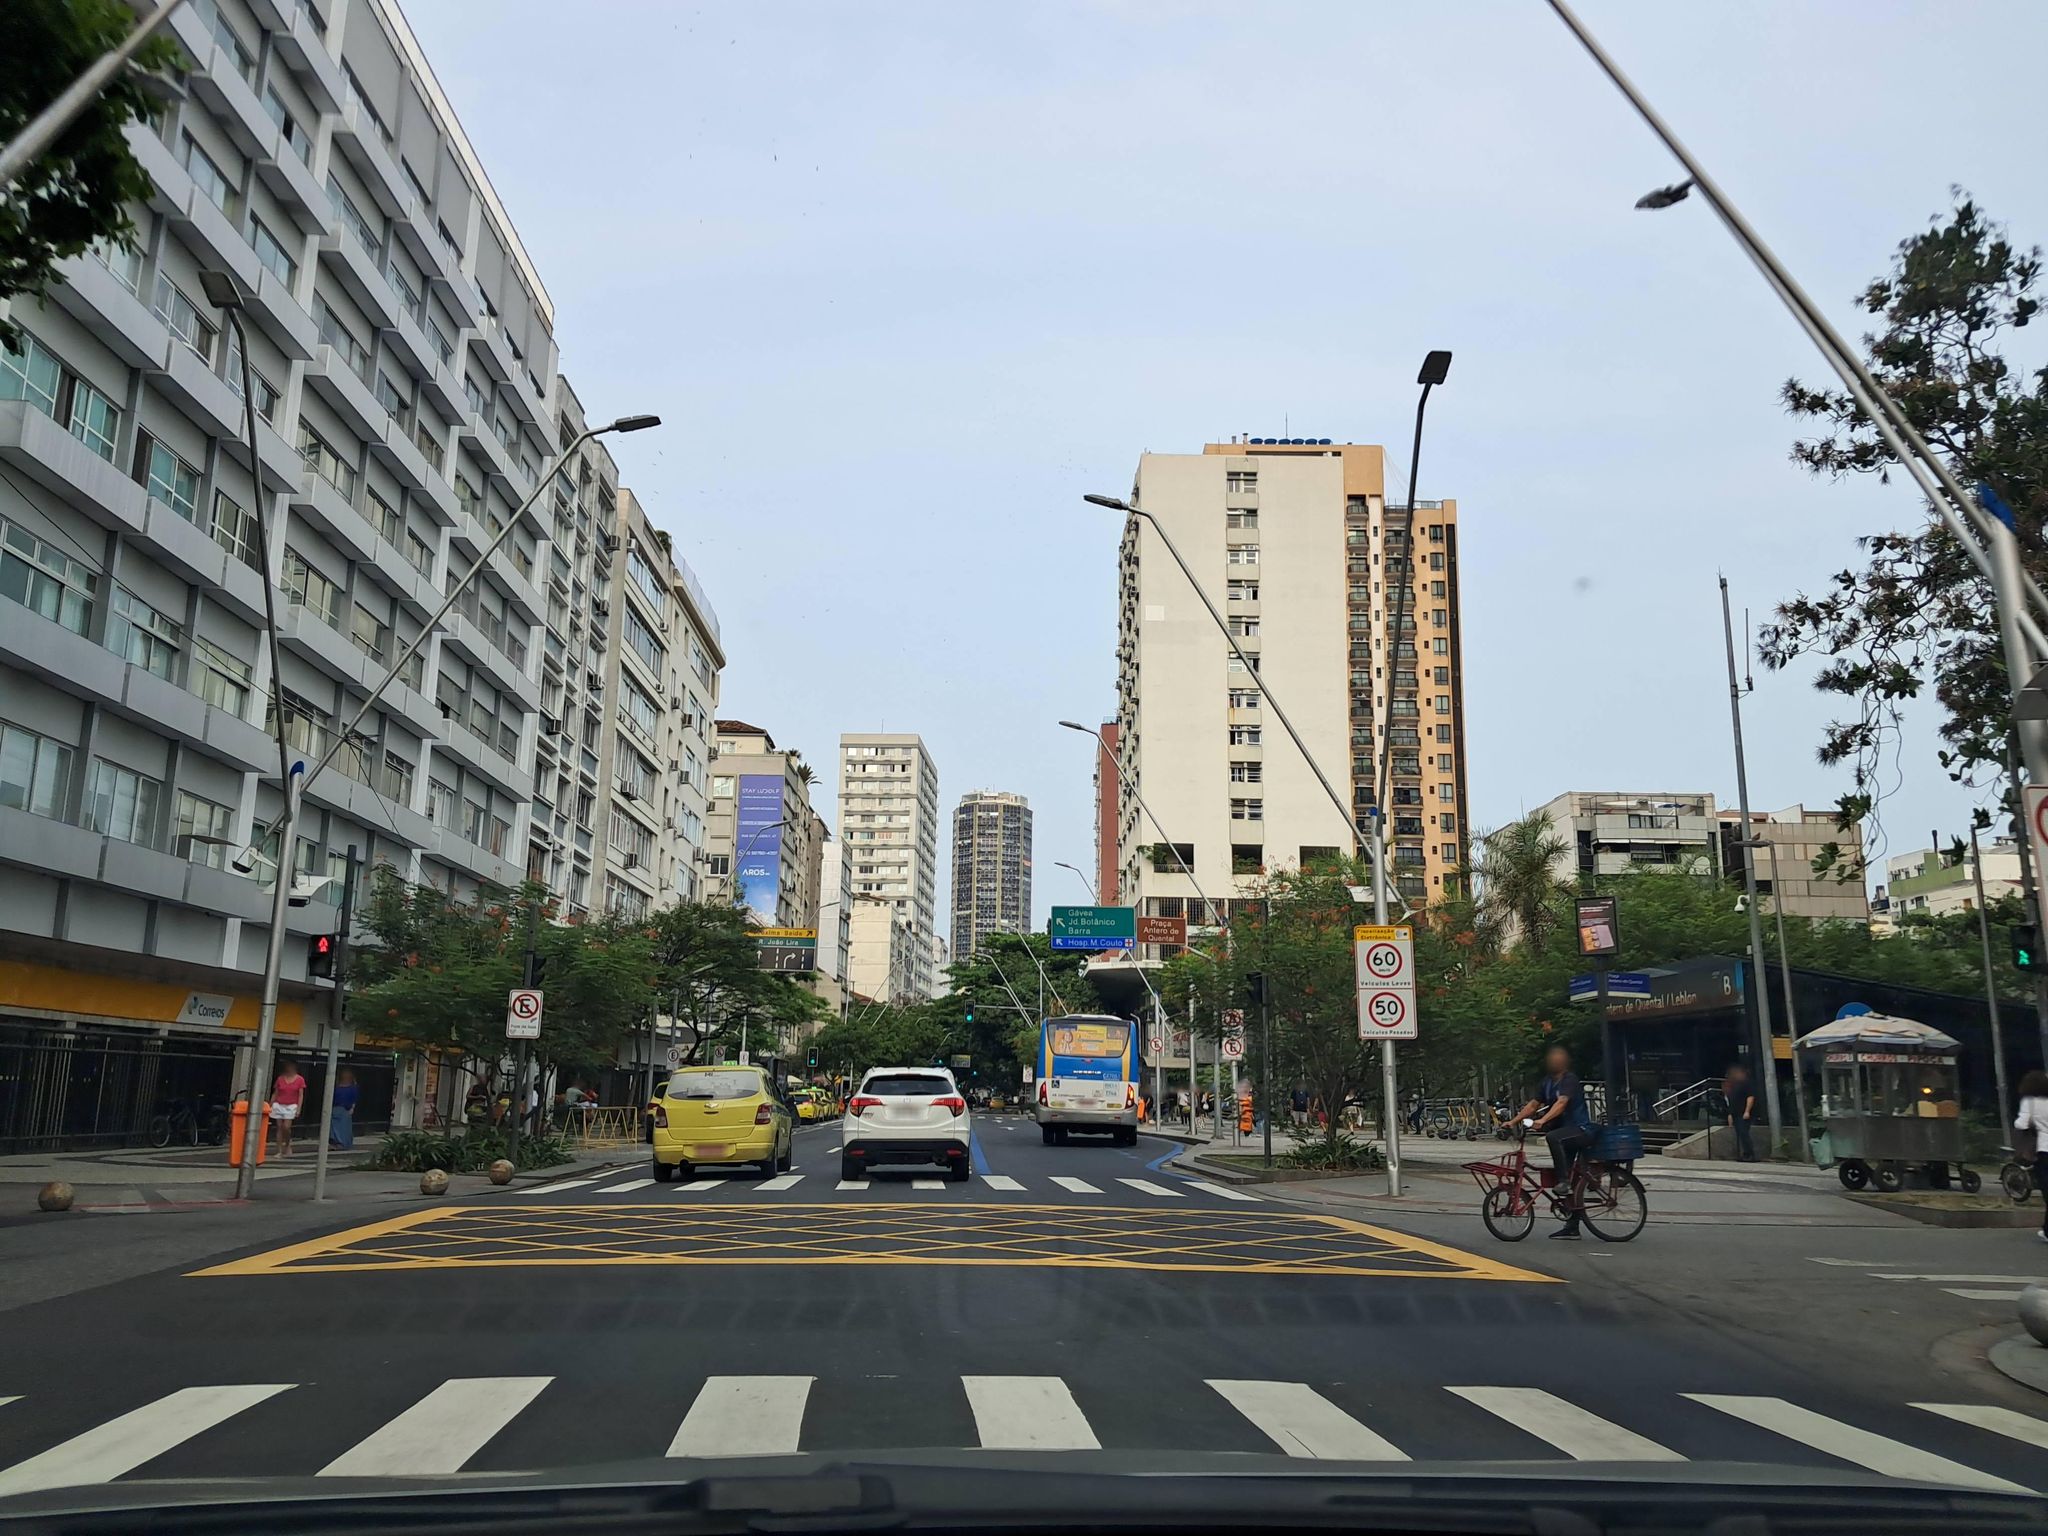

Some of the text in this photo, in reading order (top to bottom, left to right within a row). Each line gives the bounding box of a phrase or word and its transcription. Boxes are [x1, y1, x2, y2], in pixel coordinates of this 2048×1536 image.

[742, 868, 765, 876] AROS
[1068, 909, 1093, 917] Gávea
[1081, 918, 1116, 926] Botânico
[1150, 919, 1172, 928] Praça
[1068, 927, 1091, 935] Barra
[1143, 926, 1179, 935] Antero de
[1147, 934, 1175, 942] Quental
[1373, 951, 1396, 966] 60
[1723, 975, 1732, 996] B
[1625, 999, 1634, 1013] de
[1635, 994, 1665, 1011] Quental
[1671, 990, 1697, 1007] Leblon
[198, 1004, 225, 1018] Correios
[1375, 1000, 1398, 1015] 50
